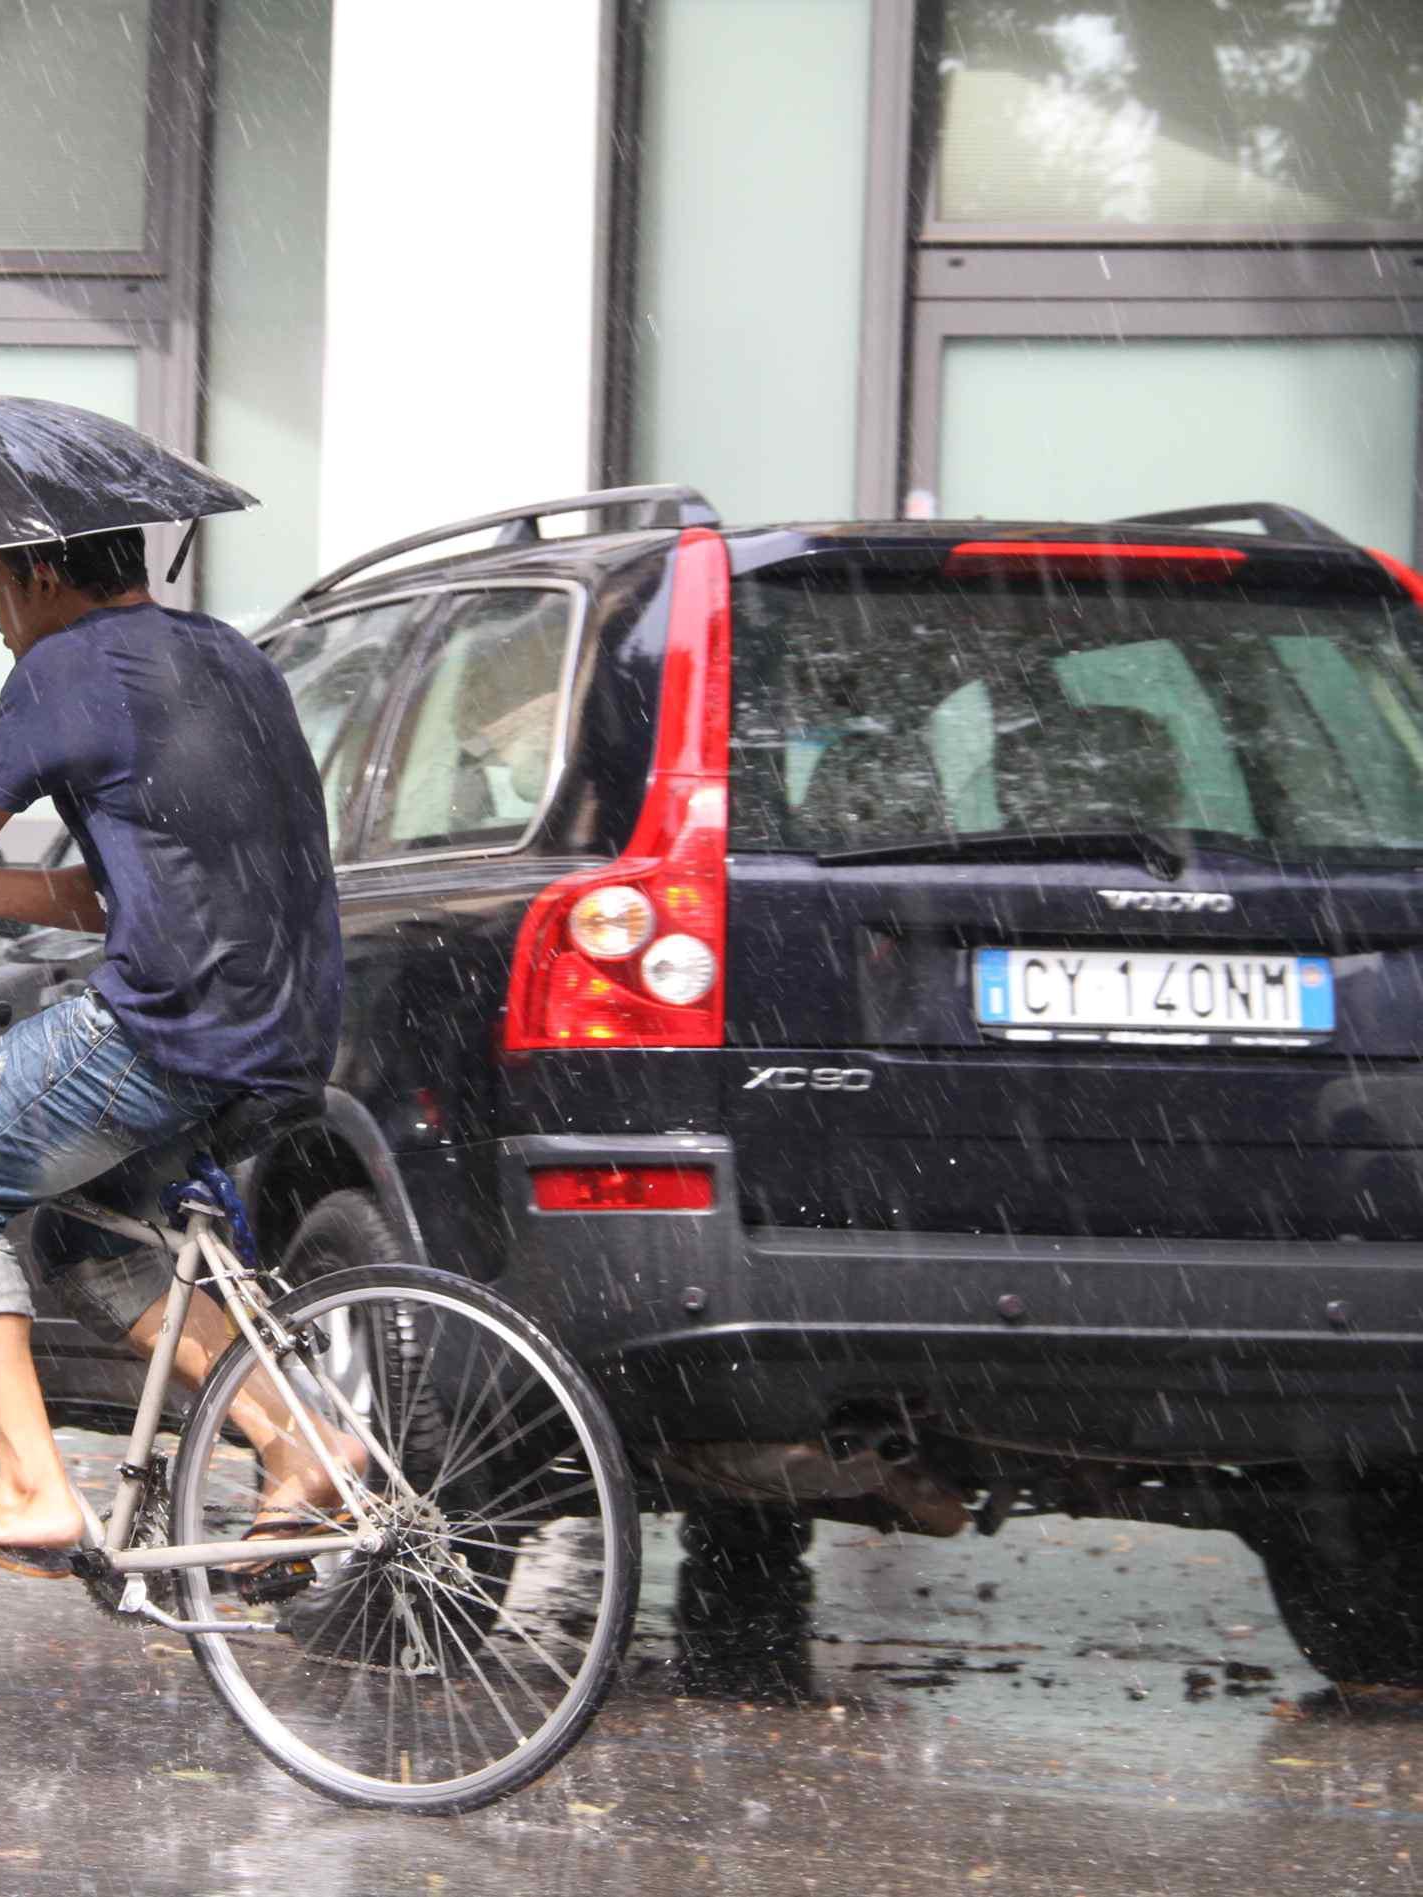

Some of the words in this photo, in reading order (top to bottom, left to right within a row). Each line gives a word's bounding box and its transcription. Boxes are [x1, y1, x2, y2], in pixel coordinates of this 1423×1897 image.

[1097, 889, 1233, 913] VOLVO
[1024, 958, 1083, 1015] CY
[1117, 960, 1289, 1020] 140NM
[742, 1066, 873, 1091] XC90
